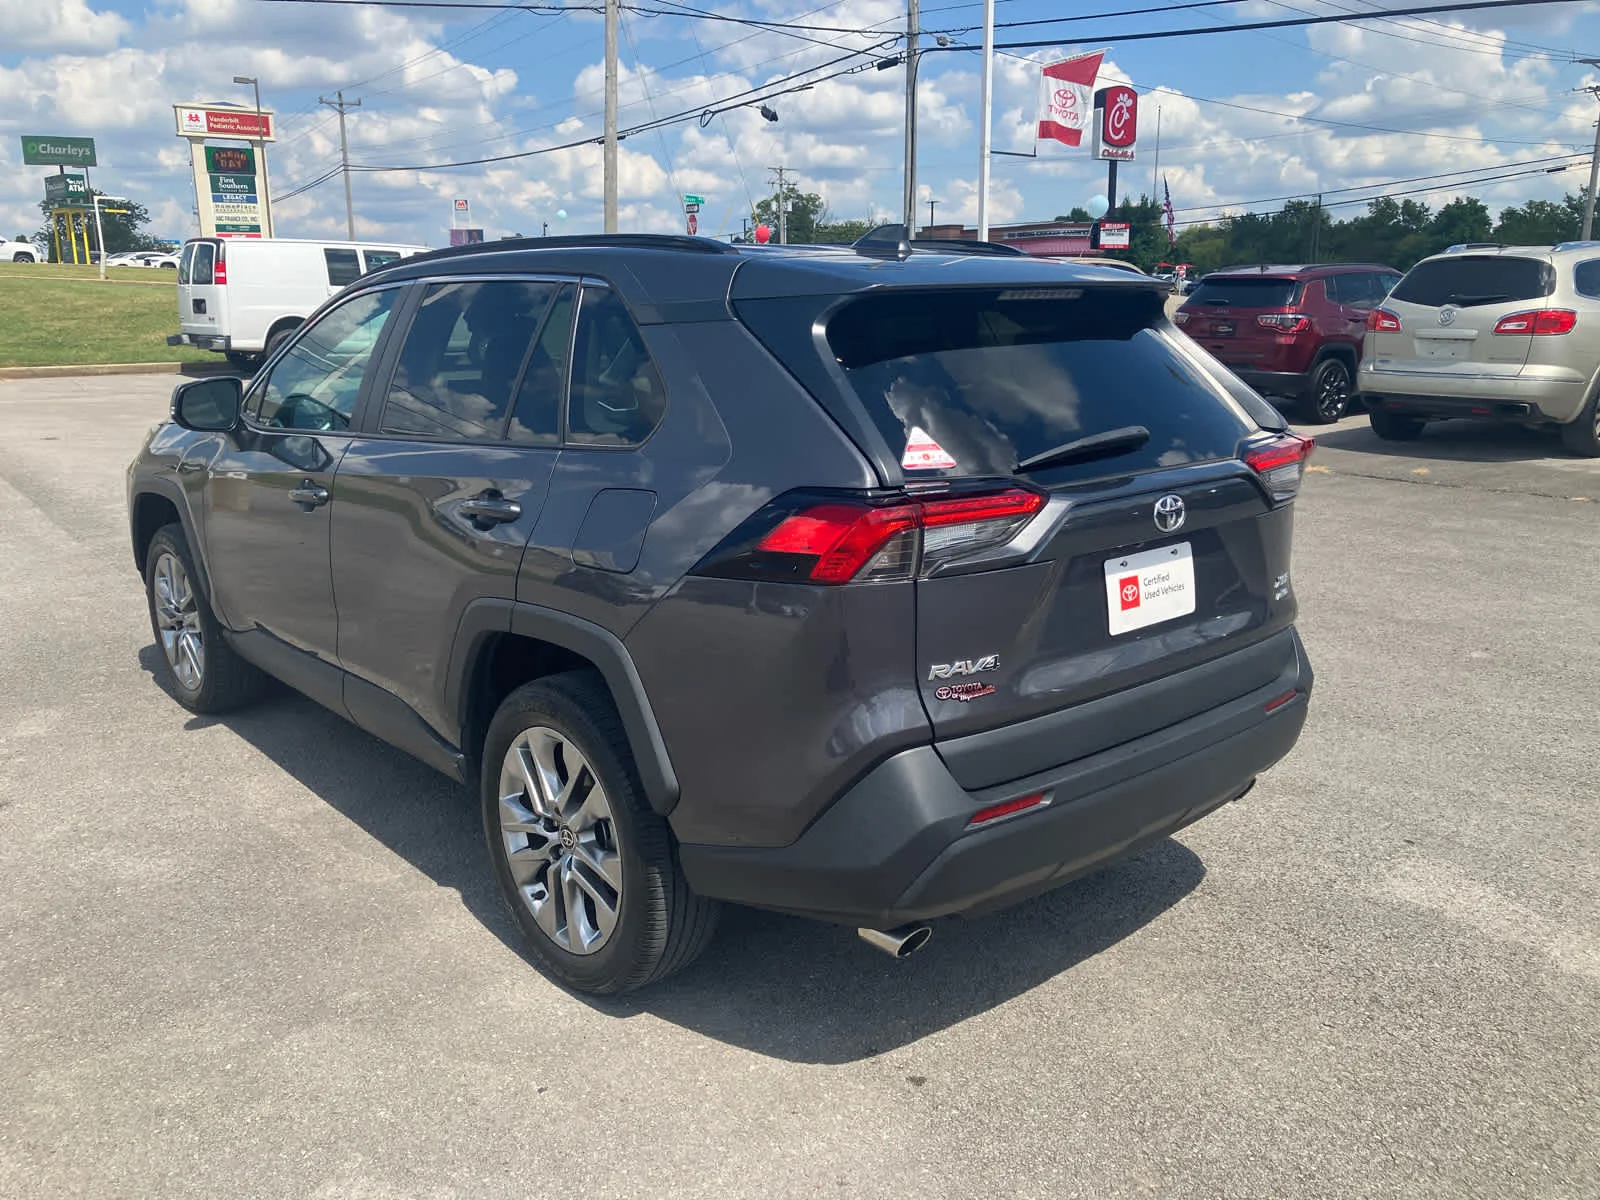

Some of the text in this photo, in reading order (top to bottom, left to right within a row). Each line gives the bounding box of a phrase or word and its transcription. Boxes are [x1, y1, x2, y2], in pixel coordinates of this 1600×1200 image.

[209, 115, 239, 123] Vanderbilt
[1048, 104, 1080, 121] TOYOTA
[38, 143, 90, 157] Charleys
[68, 184, 85, 192] ATM
[219, 182, 249, 190] Southern
[1143, 573, 1170, 588] Certified
[1144, 583, 1185, 601] Used Vehicles
[928, 654, 1000, 681] RAV4
[951, 682, 983, 693] TOYOTA
